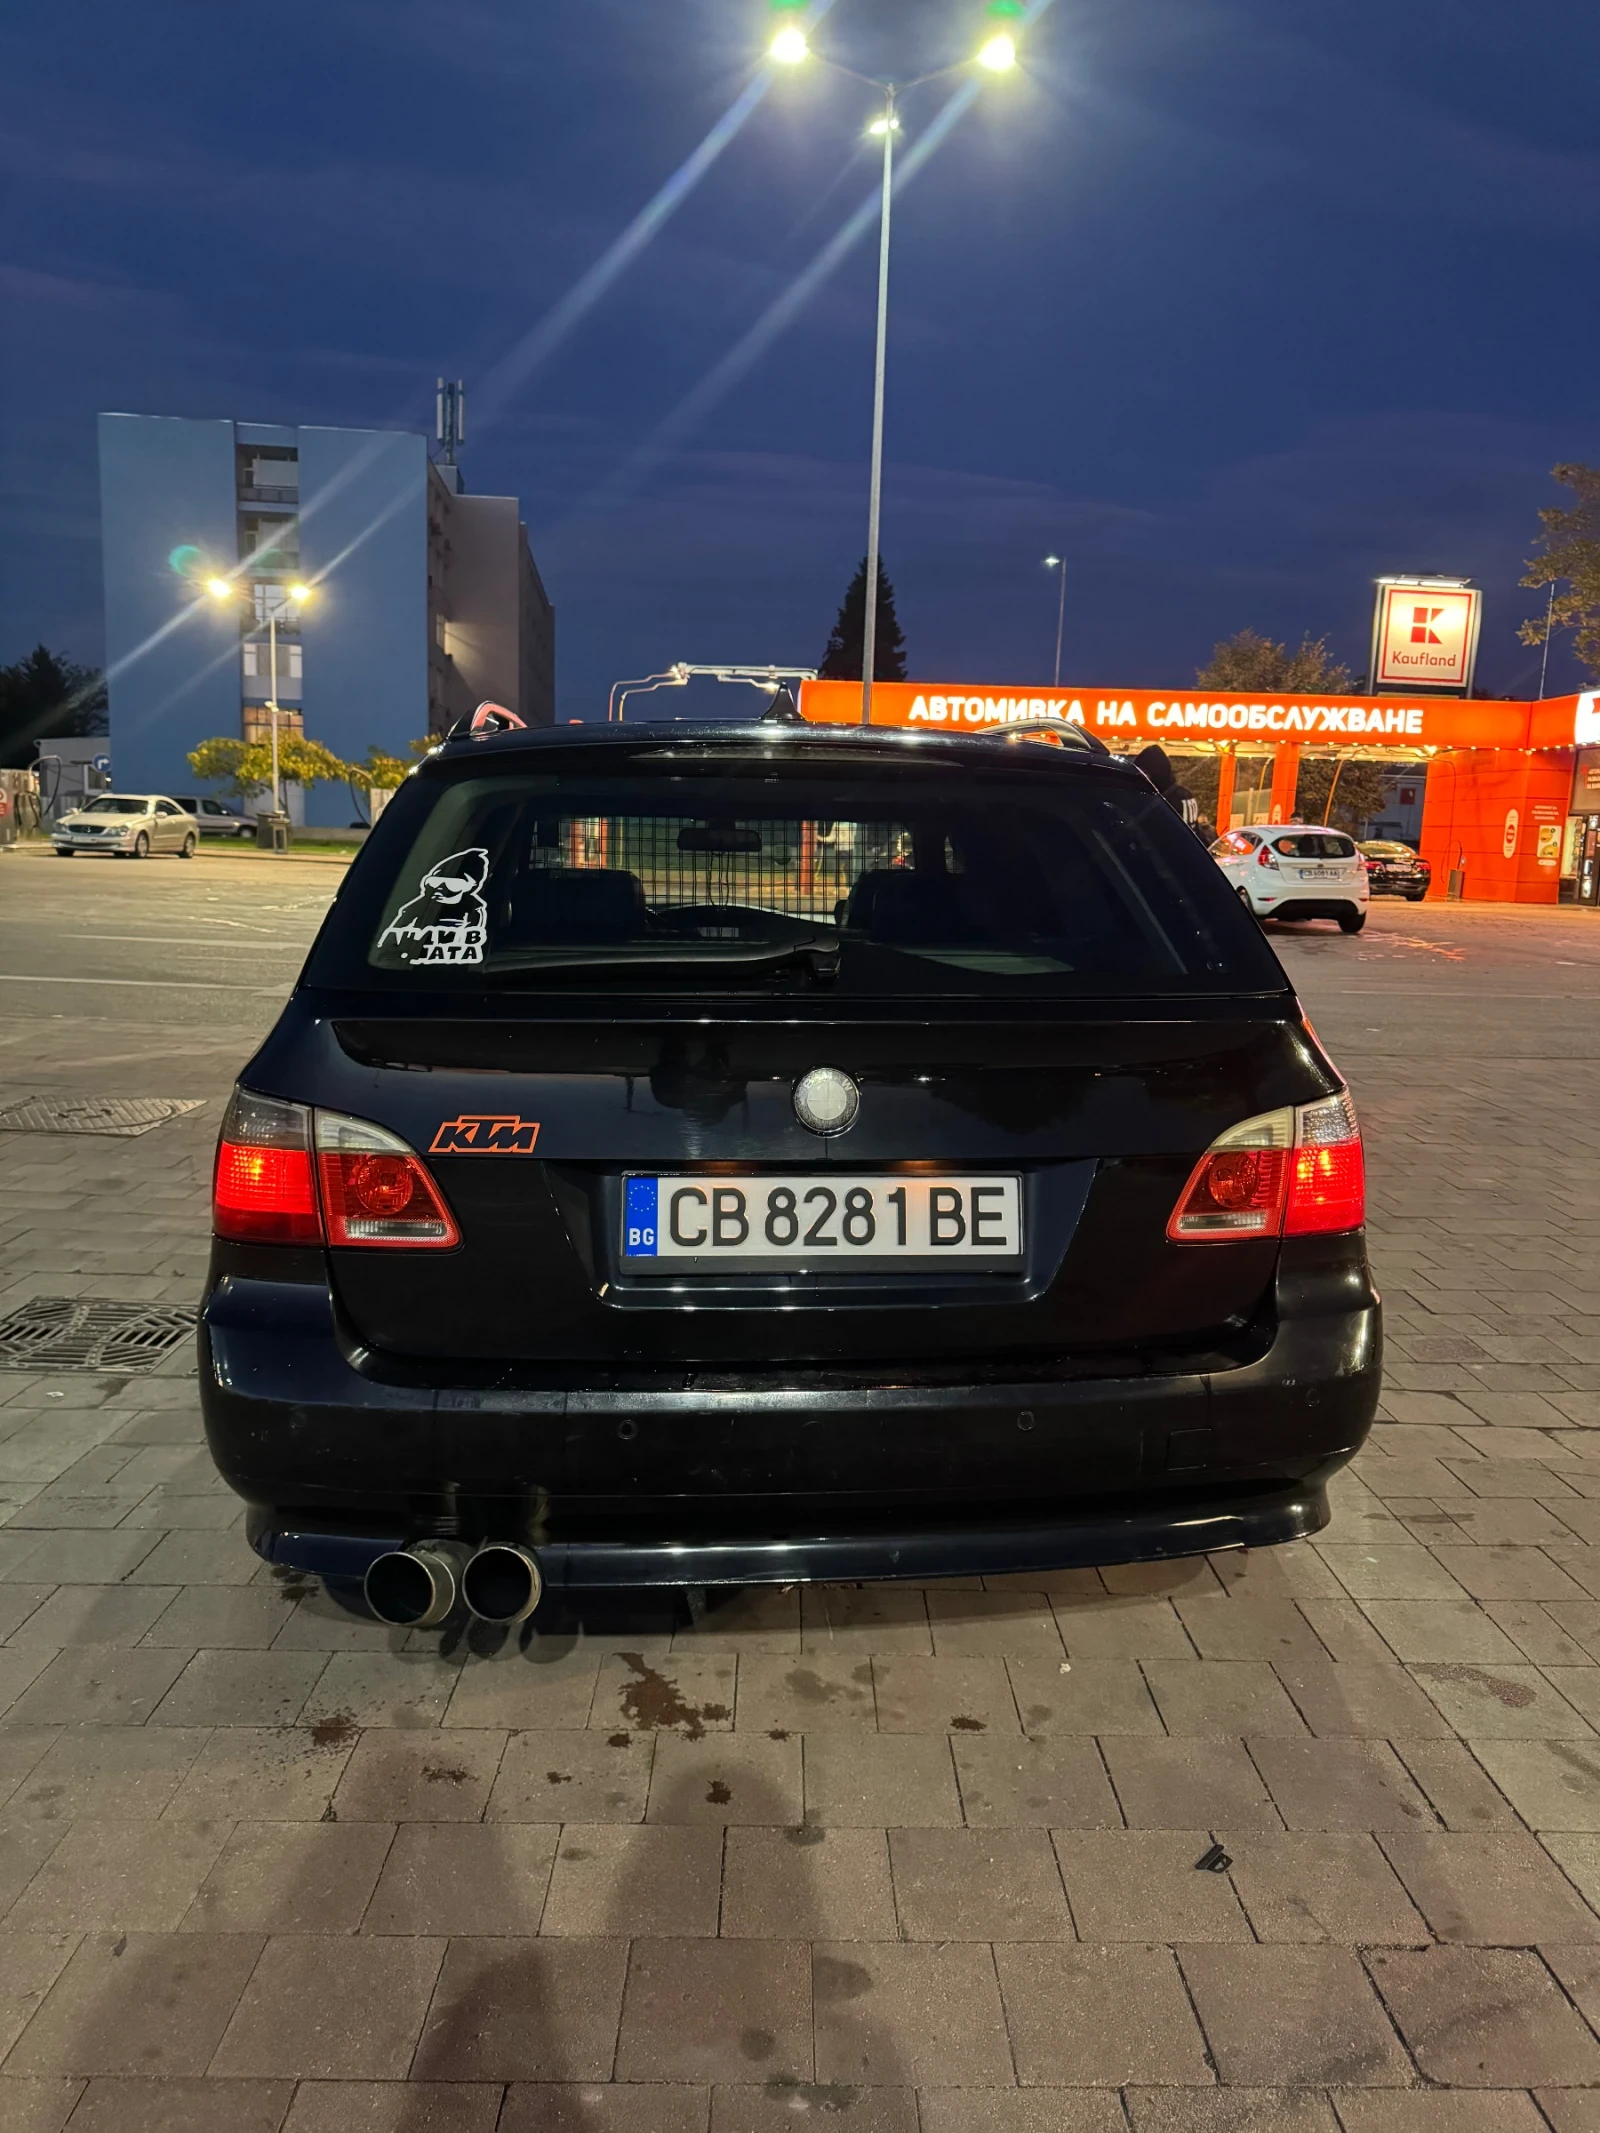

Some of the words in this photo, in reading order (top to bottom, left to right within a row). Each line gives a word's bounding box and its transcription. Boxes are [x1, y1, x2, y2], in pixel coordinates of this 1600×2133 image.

[1392, 651, 1457, 667] Kaufland
[908, 696, 1086, 725] АВТОМИВКА
[1096, 700, 1137, 726] НА
[1147, 702, 1424, 734] САМООБСЛУЖВАНЕ
[428, 1115, 540, 1153] KTM
[669, 1186, 750, 1247] CB
[764, 1186, 908, 1247] 8281
[929, 1186, 1008, 1247] BE
[628, 1227, 655, 1246] BG
